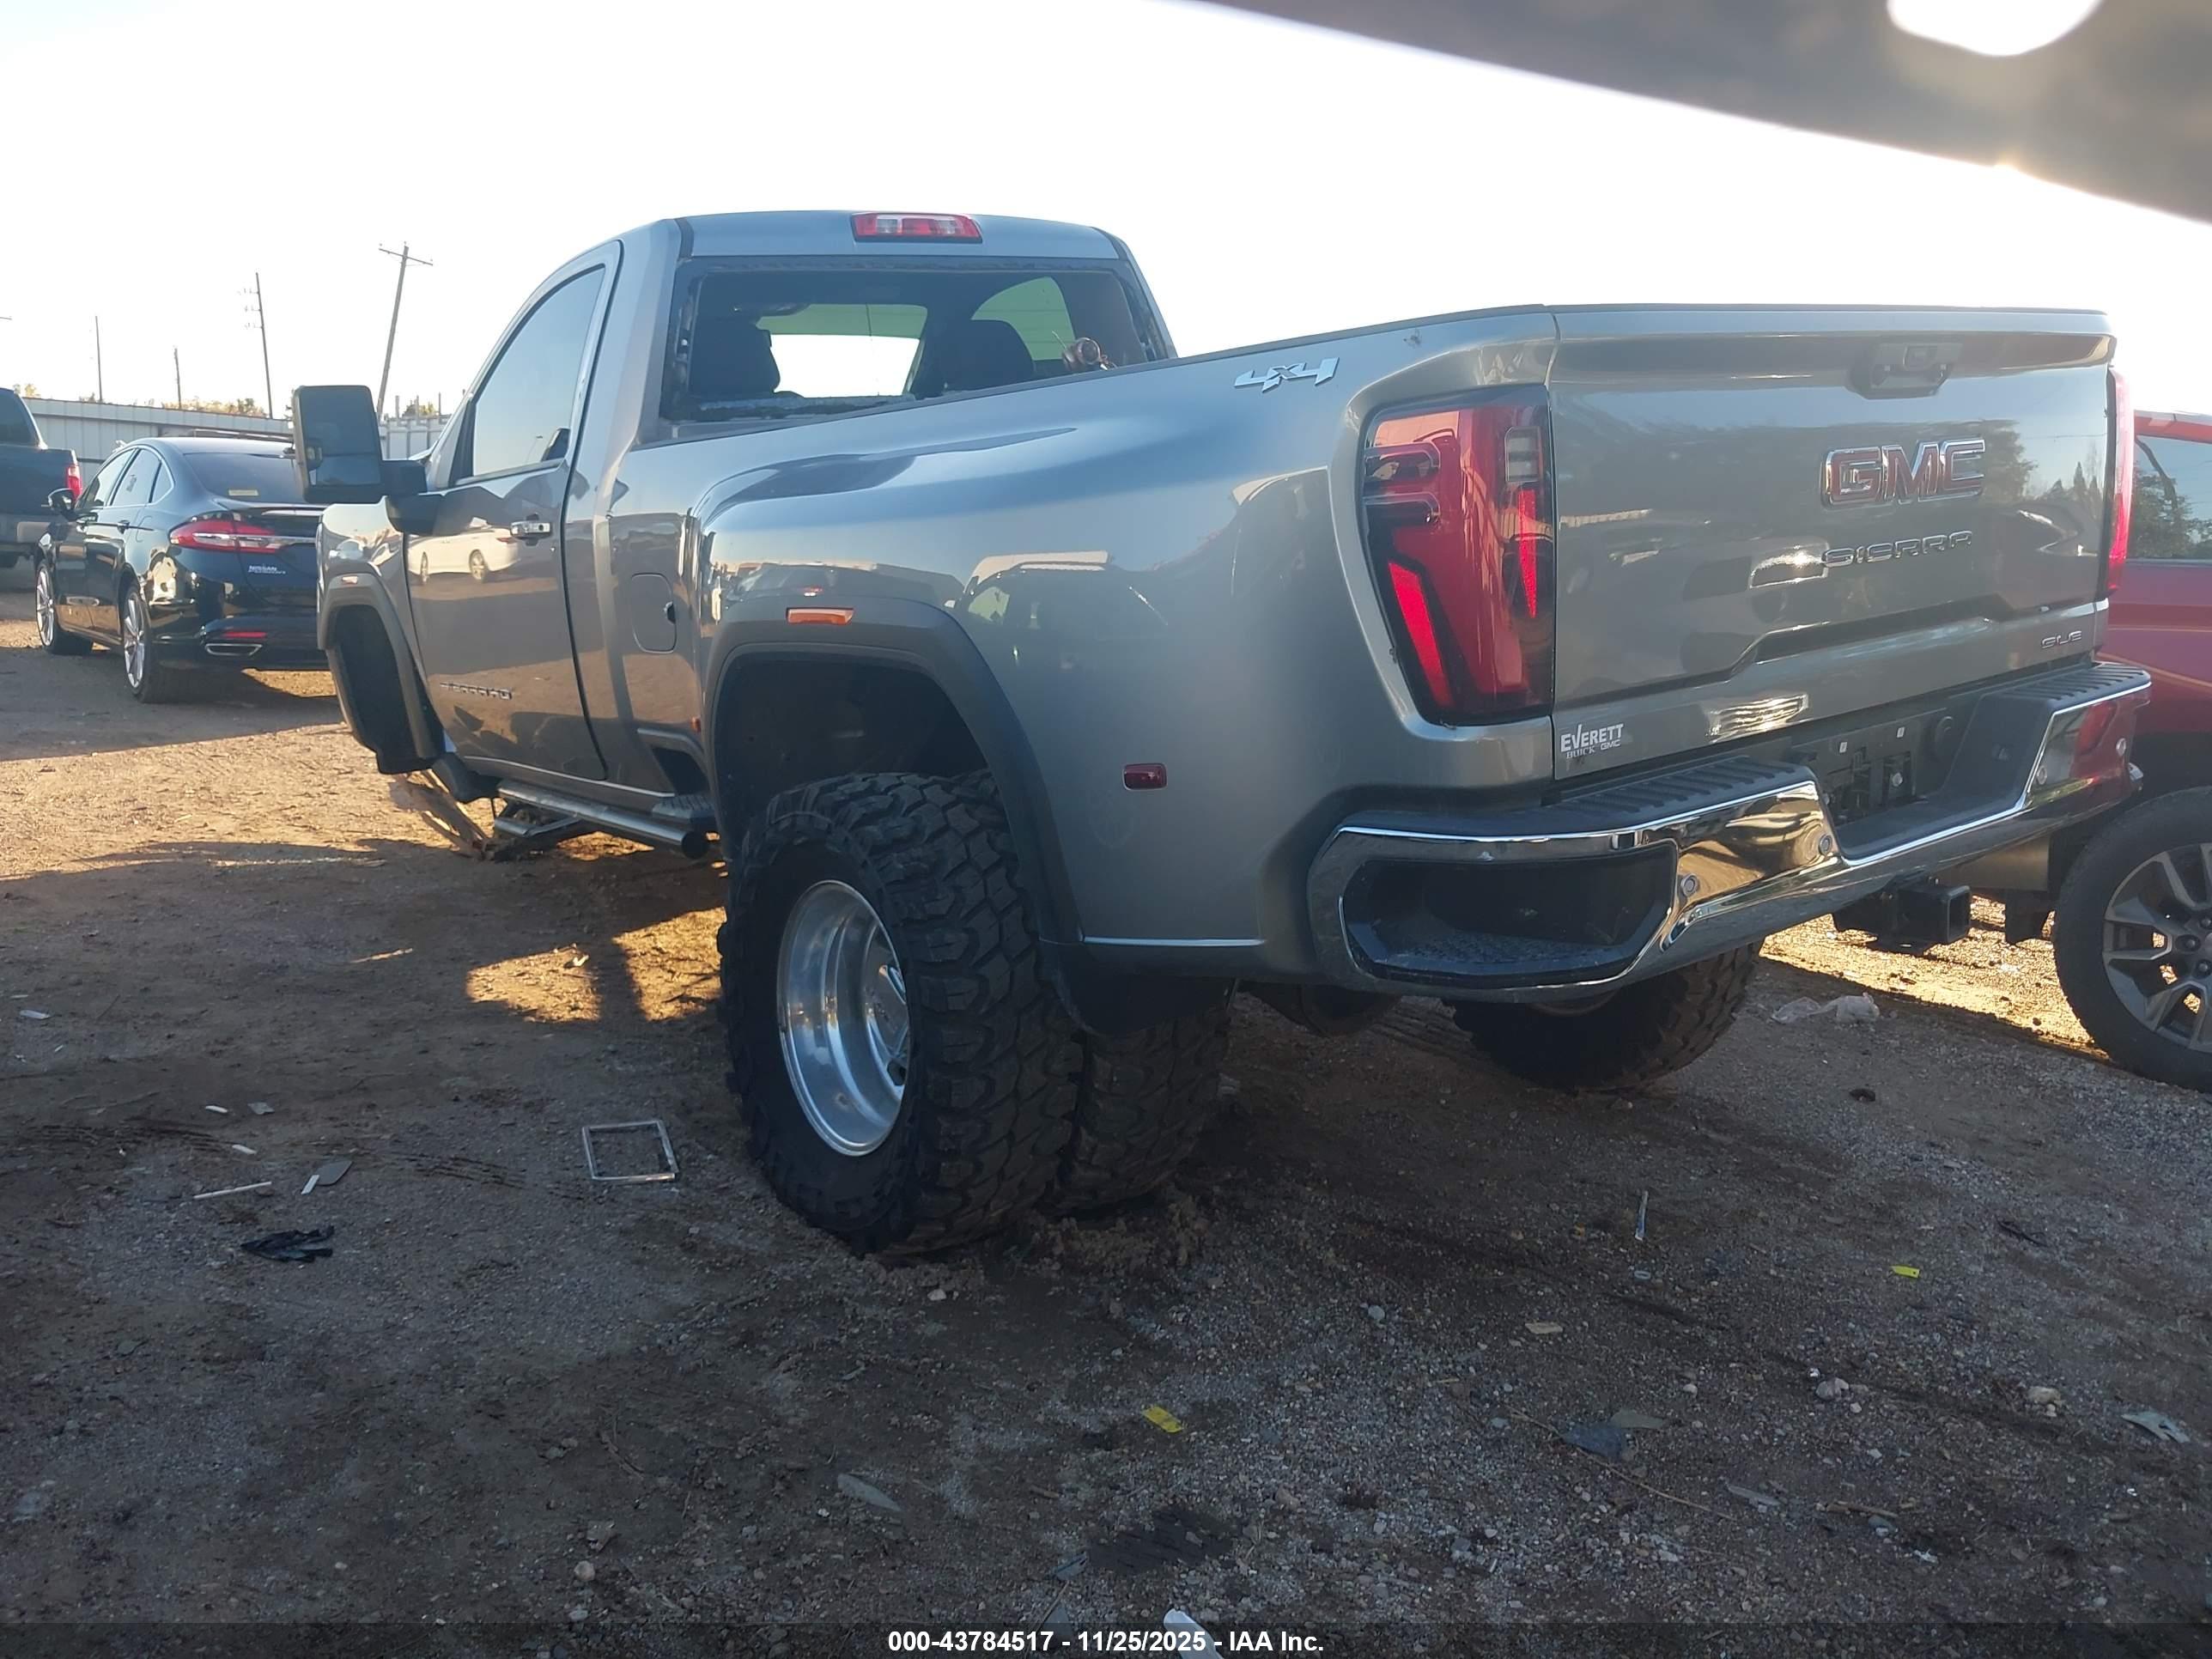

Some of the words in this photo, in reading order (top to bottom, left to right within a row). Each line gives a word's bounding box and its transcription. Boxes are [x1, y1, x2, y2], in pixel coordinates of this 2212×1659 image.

[1821, 438, 1985, 509] GMC
[1821, 529, 1973, 568] SIERRA
[1560, 723, 1625, 753] EVERETT
[1600, 738, 1621, 750] GMC
